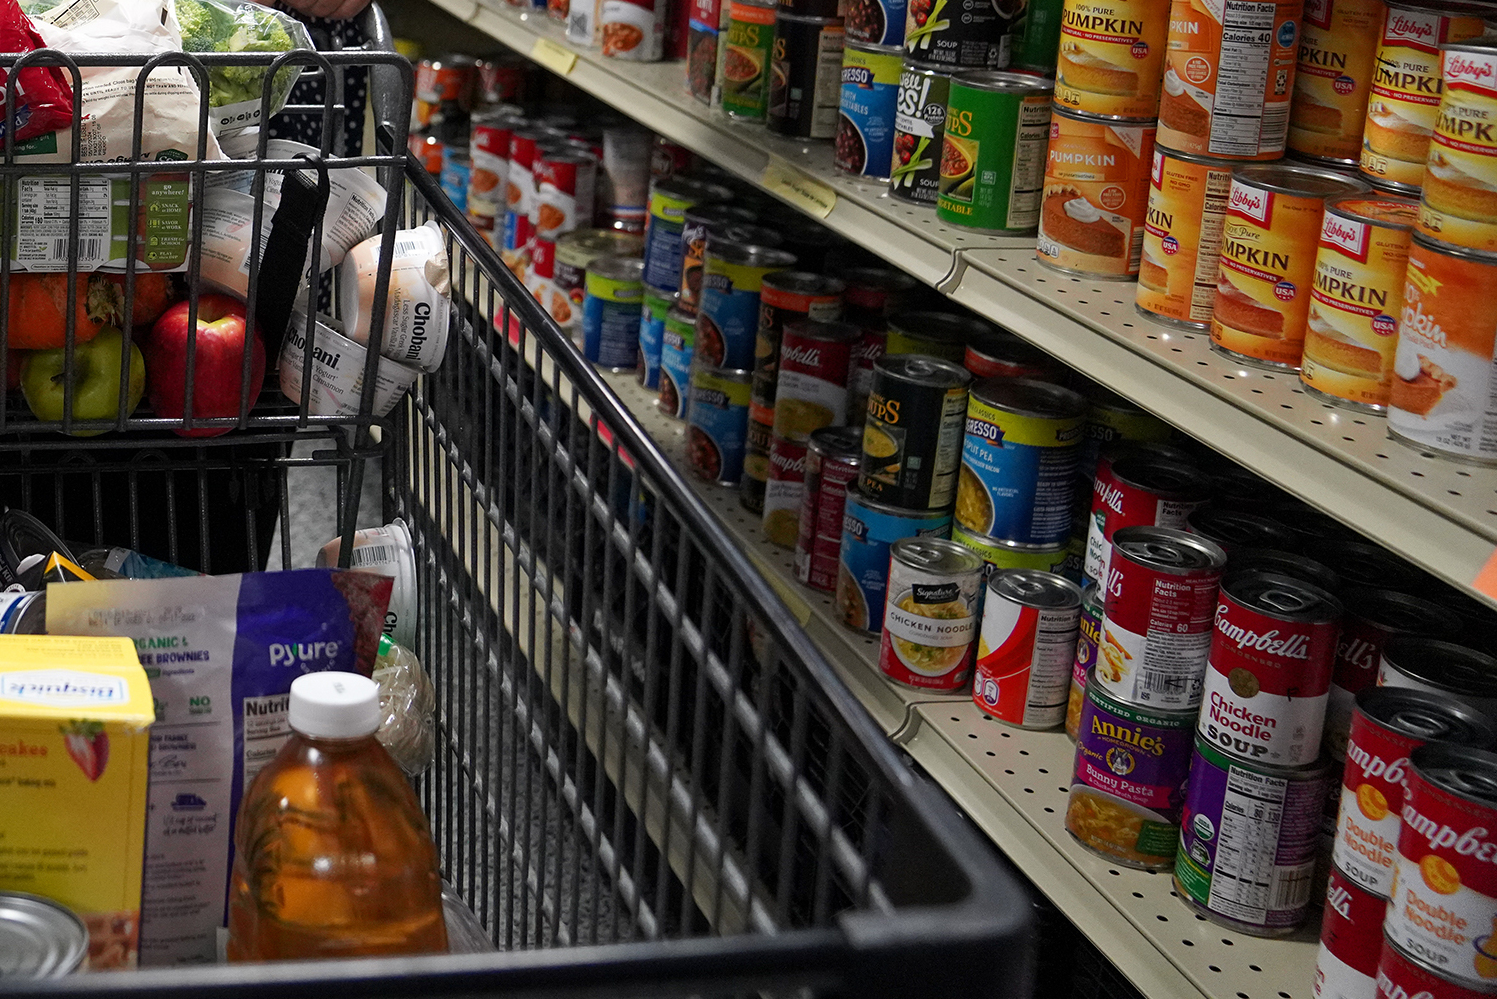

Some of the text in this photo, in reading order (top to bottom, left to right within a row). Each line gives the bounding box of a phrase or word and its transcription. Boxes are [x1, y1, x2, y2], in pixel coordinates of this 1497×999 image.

[1092, 6, 1115, 16] PURE
[1226, 0, 1274, 13] Nutrition Facts
[1063, 9, 1143, 35] PUMPKIN
[1390, 15, 1434, 37] Libby's
[936, 39, 958, 50] SOUP
[1093, 33, 1133, 44] PRESERVATIVES
[1223, 32, 1271, 43] Calories 40
[1132, 47, 1148, 55] USA
[1403, 62, 1429, 73] PURE
[1445, 56, 1493, 79] Libby's
[1335, 81, 1352, 91] USA
[923, 113, 945, 124] Protein
[1459, 107, 1489, 119] PURE
[1050, 149, 1115, 166] PUMPKIN
[152, 189, 184, 197] anywhere!
[163, 184, 172, 192] go
[1231, 189, 1261, 210] Libby's
[1240, 225, 1260, 240] Pure
[1323, 217, 1357, 242] Libby's
[1163, 242, 1178, 251] USA
[1237, 264, 1277, 282] PRESERVATIVES
[1330, 266, 1352, 279] PURE
[1275, 288, 1295, 297] USA
[392, 287, 402, 327] Madagascar
[1330, 297, 1374, 316] PRESERVATIVES
[406, 302, 431, 361] Chobani
[1373, 322, 1394, 332] USA
[287, 326, 341, 371] Choani
[312, 373, 344, 395] Cinnamon
[979, 448, 993, 463] PEA
[916, 586, 954, 600] Signature
[1155, 579, 1192, 593] Nutrition
[1155, 587, 1178, 599] Facts
[890, 611, 973, 634] CHICKEN NOODLE
[1041, 614, 1071, 623] Nutrition
[1177, 623, 1189, 634] 60
[1214, 603, 1310, 660] Campbell's
[156, 650, 211, 664] BROWNIES
[269, 641, 339, 667] pyure
[1220, 640, 1282, 669] CONDENSED
[9, 679, 115, 700] Bisquick
[1089, 691, 1180, 727] CERTIFIED ORGANIC
[1211, 690, 1276, 729] Chicken
[1209, 706, 1272, 742] Noodle
[1091, 714, 1166, 757] Annie's
[1102, 735, 1145, 754] HOMEGROWN
[1207, 723, 1269, 756] SOUP
[1077, 740, 1103, 762] Organic
[1086, 763, 1154, 798] Bunny Pasta
[1230, 766, 1286, 788] Nutrition Facts
[1346, 816, 1394, 853] Double
[1344, 833, 1393, 868] Noodle
[1345, 861, 1378, 887] SOUP
[1407, 887, 1468, 930] Double
[1404, 903, 1466, 944] Noodle
[1406, 937, 1449, 965] SOUP
